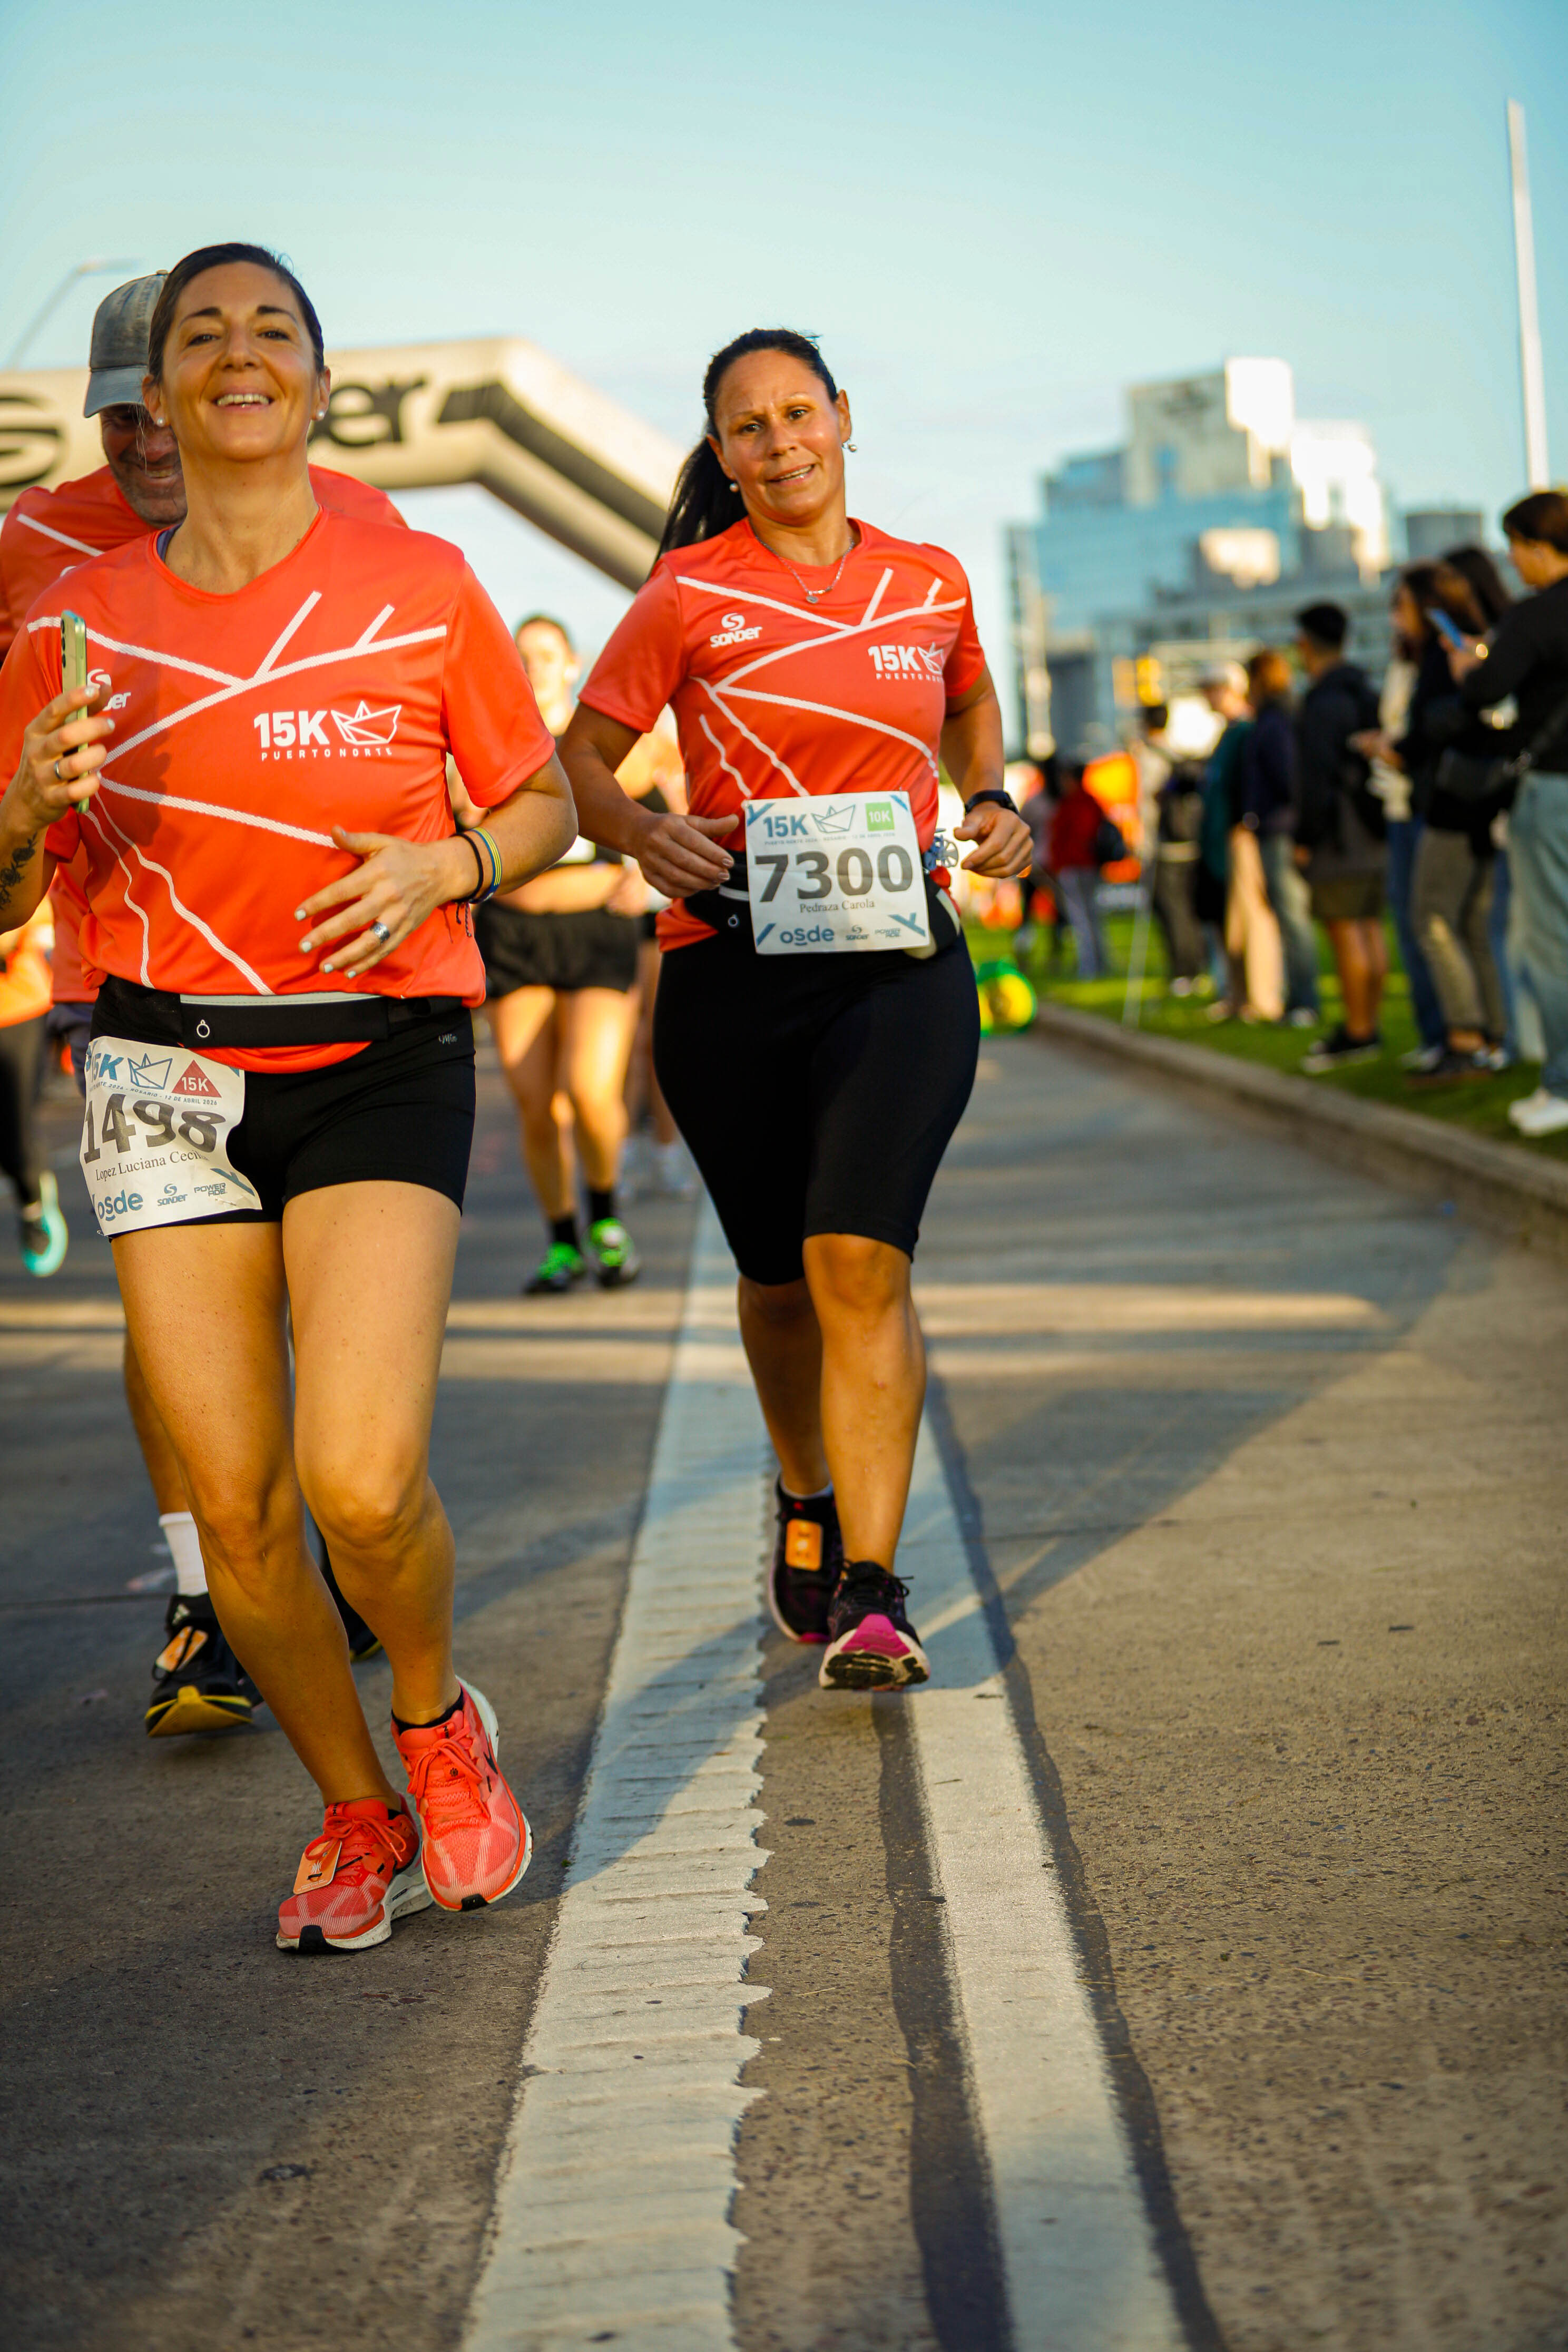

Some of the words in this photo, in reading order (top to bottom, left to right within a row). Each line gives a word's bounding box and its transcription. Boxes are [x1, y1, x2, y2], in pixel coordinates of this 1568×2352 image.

[867, 645, 922, 671] 15K
[253, 710, 330, 748] 15K
[261, 749, 330, 761] PUERTO
[339, 748, 392, 757] NORTE
[763, 814, 808, 838] 15K
[869, 810, 891, 823] 10K
[754, 845, 913, 903] 7300
[800, 903, 839, 913] Pedraza
[841, 899, 875, 910] Carola
[780, 924, 835, 946] osde
[130, 1087, 158, 1097] ROSARIO
[181, 1076, 210, 1092] 15K
[84, 1093, 226, 1164] 1498
[95, 1166, 117, 1182] Lopez
[118, 1157, 166, 1174] Luciana
[97, 1189, 143, 1222] osde
[194, 1182, 226, 1193] POWER
[208, 1188, 226, 1197] ADE
